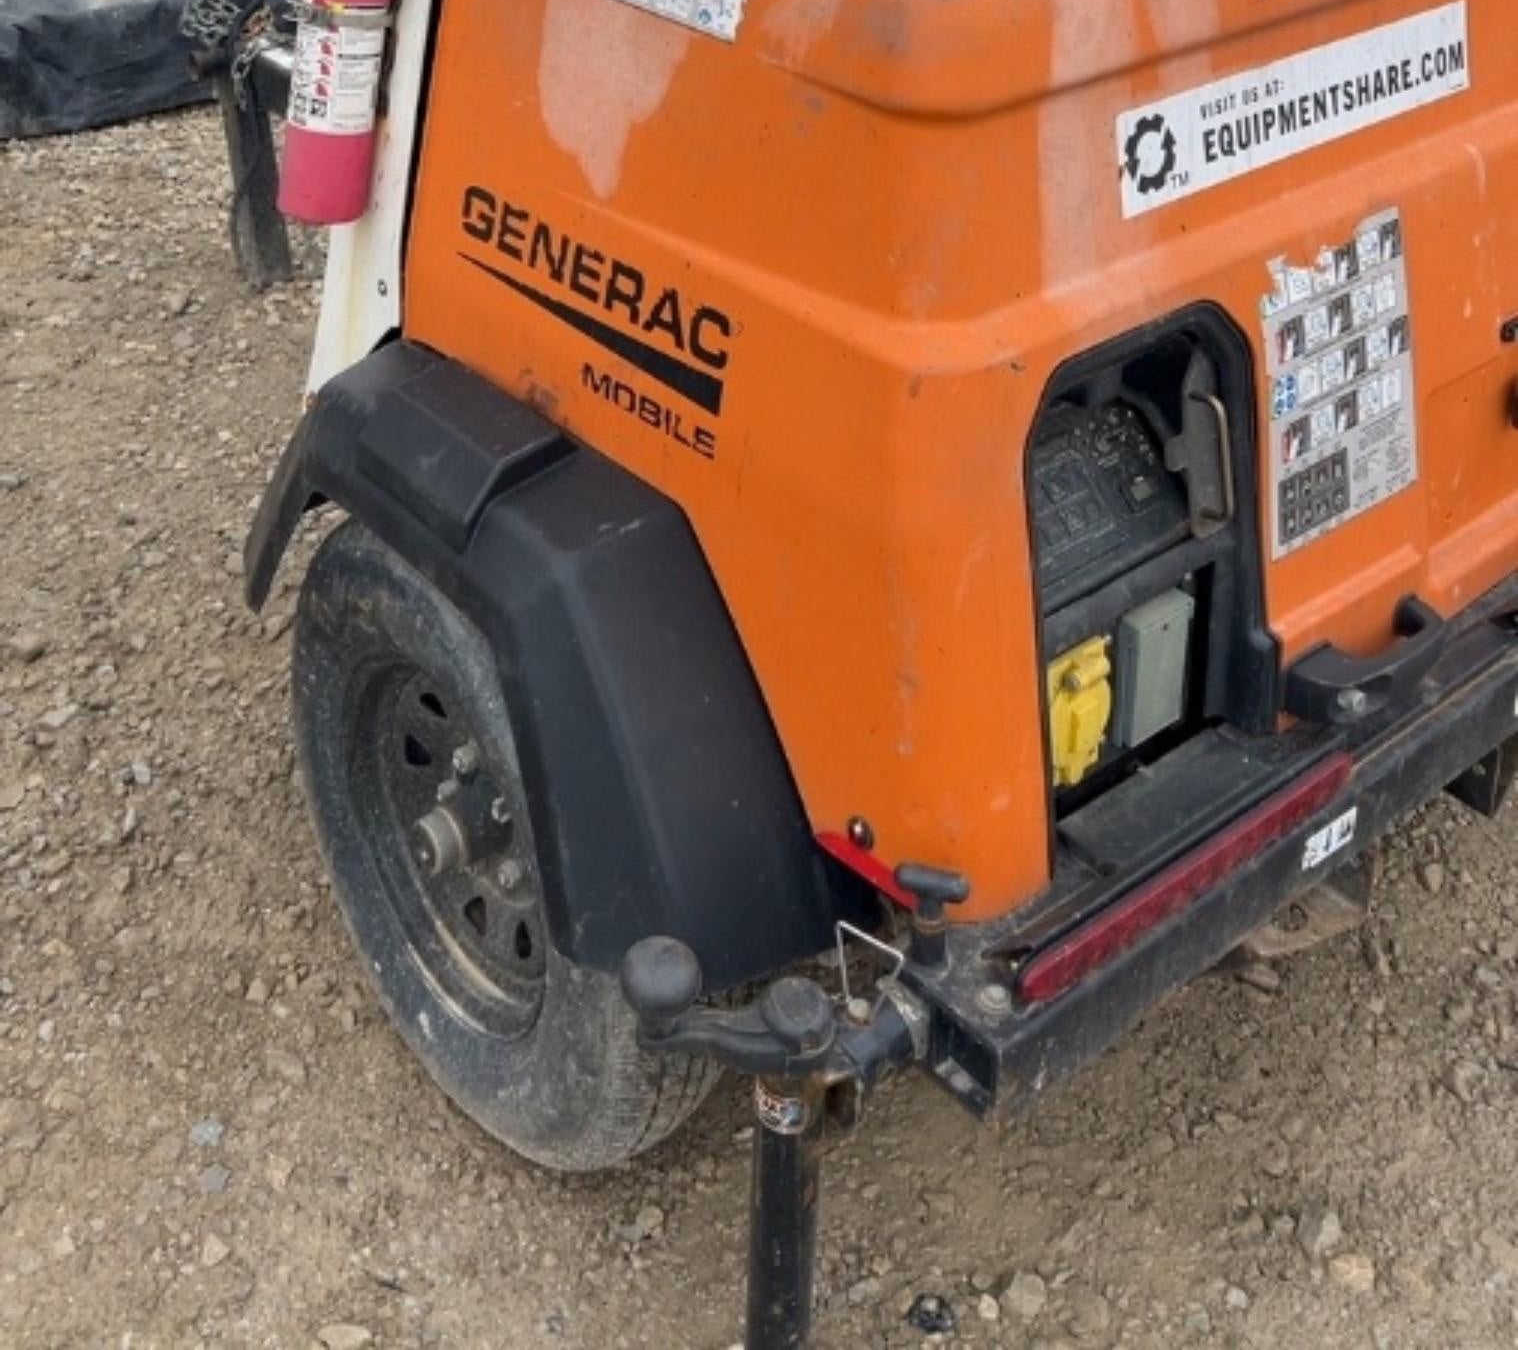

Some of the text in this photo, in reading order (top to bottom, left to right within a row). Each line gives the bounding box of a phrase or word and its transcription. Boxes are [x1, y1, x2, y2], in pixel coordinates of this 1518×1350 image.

[1200, 79, 1285, 121] VISIT US AT:
[1202, 41, 1465, 163] EQUIPMENTSHARE.COM
[462, 185, 731, 370] GENERAC
[582, 362, 716, 460] MOBILE
